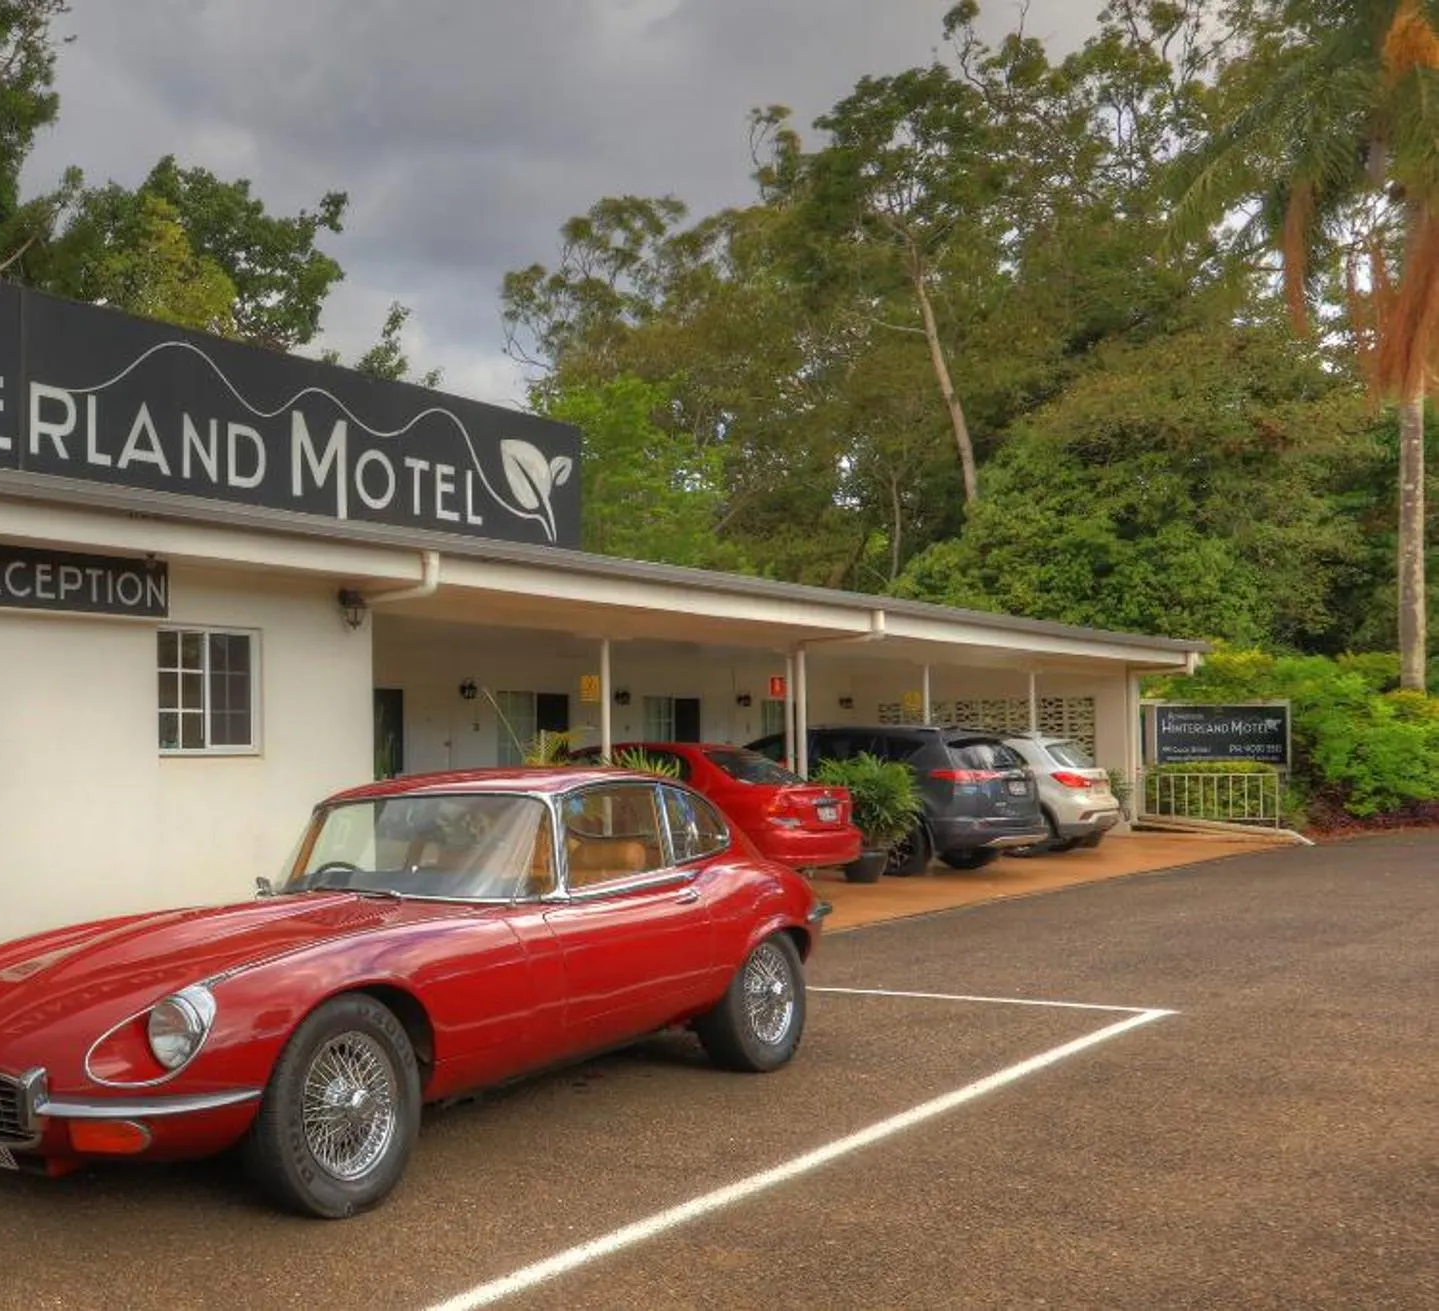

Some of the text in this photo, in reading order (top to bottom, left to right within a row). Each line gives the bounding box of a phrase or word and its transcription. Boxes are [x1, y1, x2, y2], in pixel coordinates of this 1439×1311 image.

[290, 410, 484, 527] MOTEL
[1162, 720, 1269, 736] HINTERLAND MOTEL
